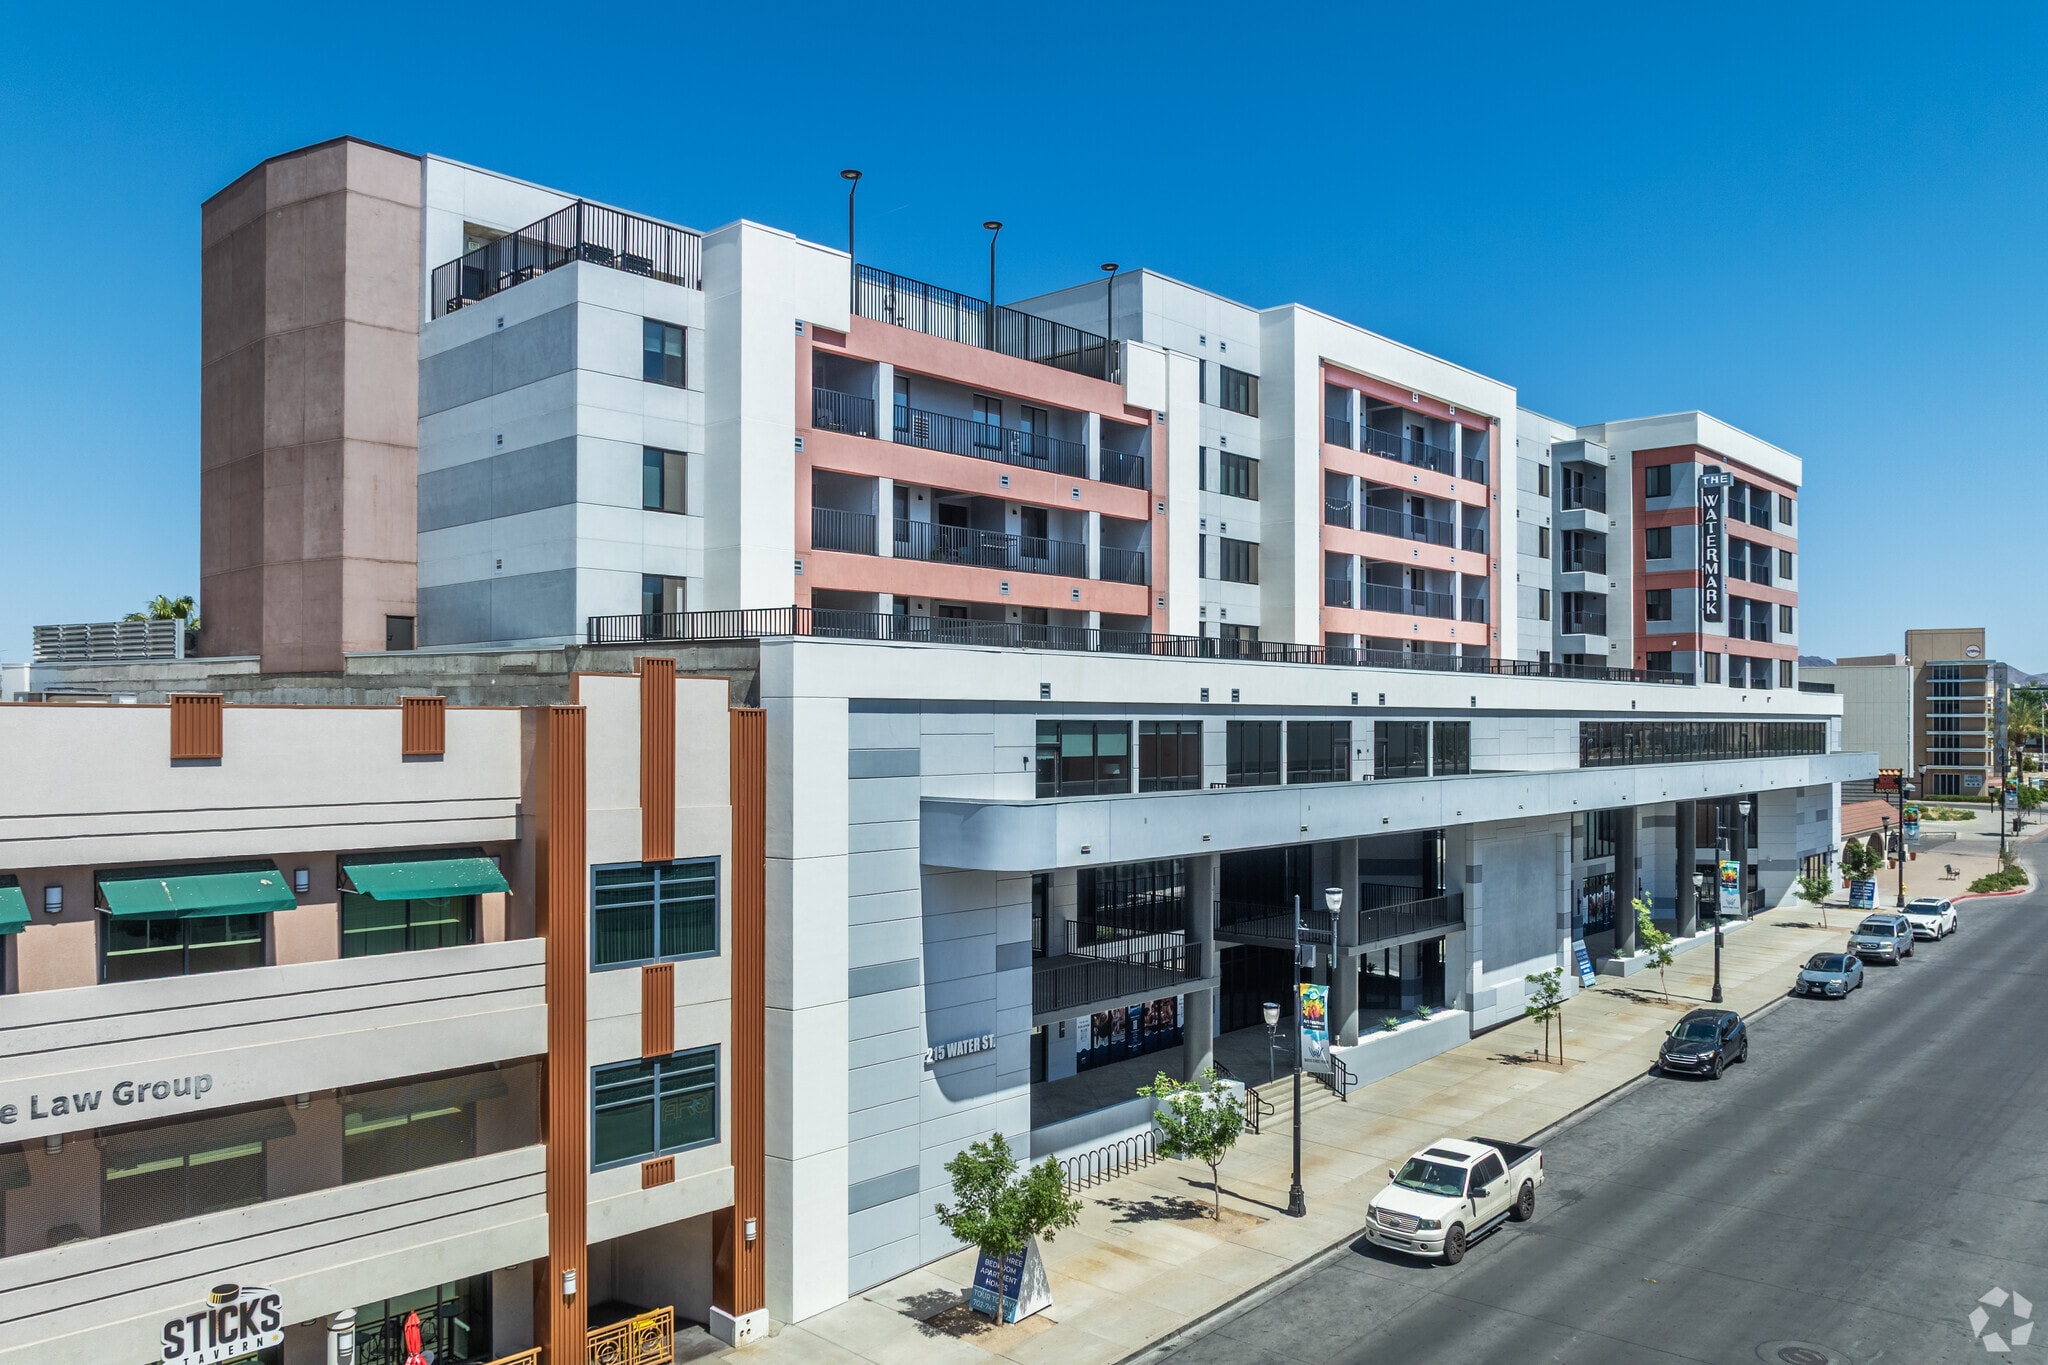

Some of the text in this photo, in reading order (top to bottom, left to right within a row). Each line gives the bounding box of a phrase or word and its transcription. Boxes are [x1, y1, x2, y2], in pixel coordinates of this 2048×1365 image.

[1701, 475, 1728, 486] THE
[1703, 494, 1719, 615] WATERMARK
[925, 1034, 996, 1064] 215 WATER ST.
[31, 1090, 102, 1120] Law
[112, 1073, 213, 1106] Group
[984, 1258, 1017, 1275] BEDOM
[974, 1289, 1015, 1309] TOUR TOAY!
[163, 1294, 280, 1359] STICKS
[184, 1337, 263, 1365] TAVERN
